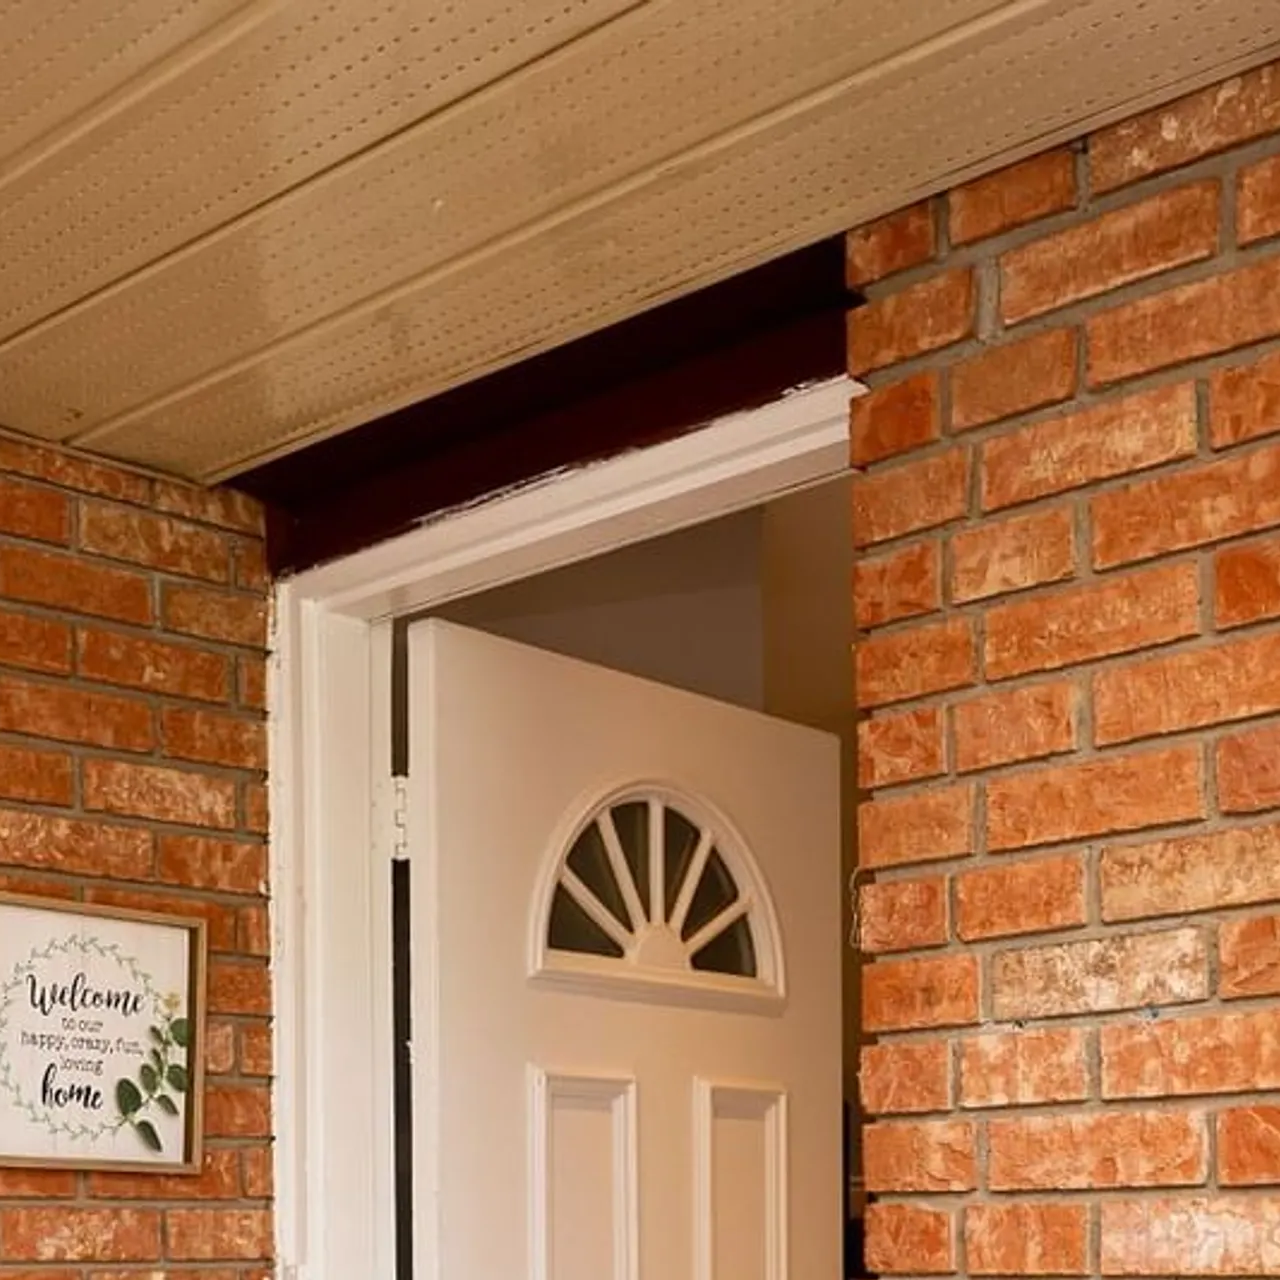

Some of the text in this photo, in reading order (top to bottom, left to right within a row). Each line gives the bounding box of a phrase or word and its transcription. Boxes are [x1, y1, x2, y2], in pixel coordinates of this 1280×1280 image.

[26, 972, 145, 1016] Welcome
[61, 1017, 104, 1033] to our
[41, 1063, 103, 1110] home
